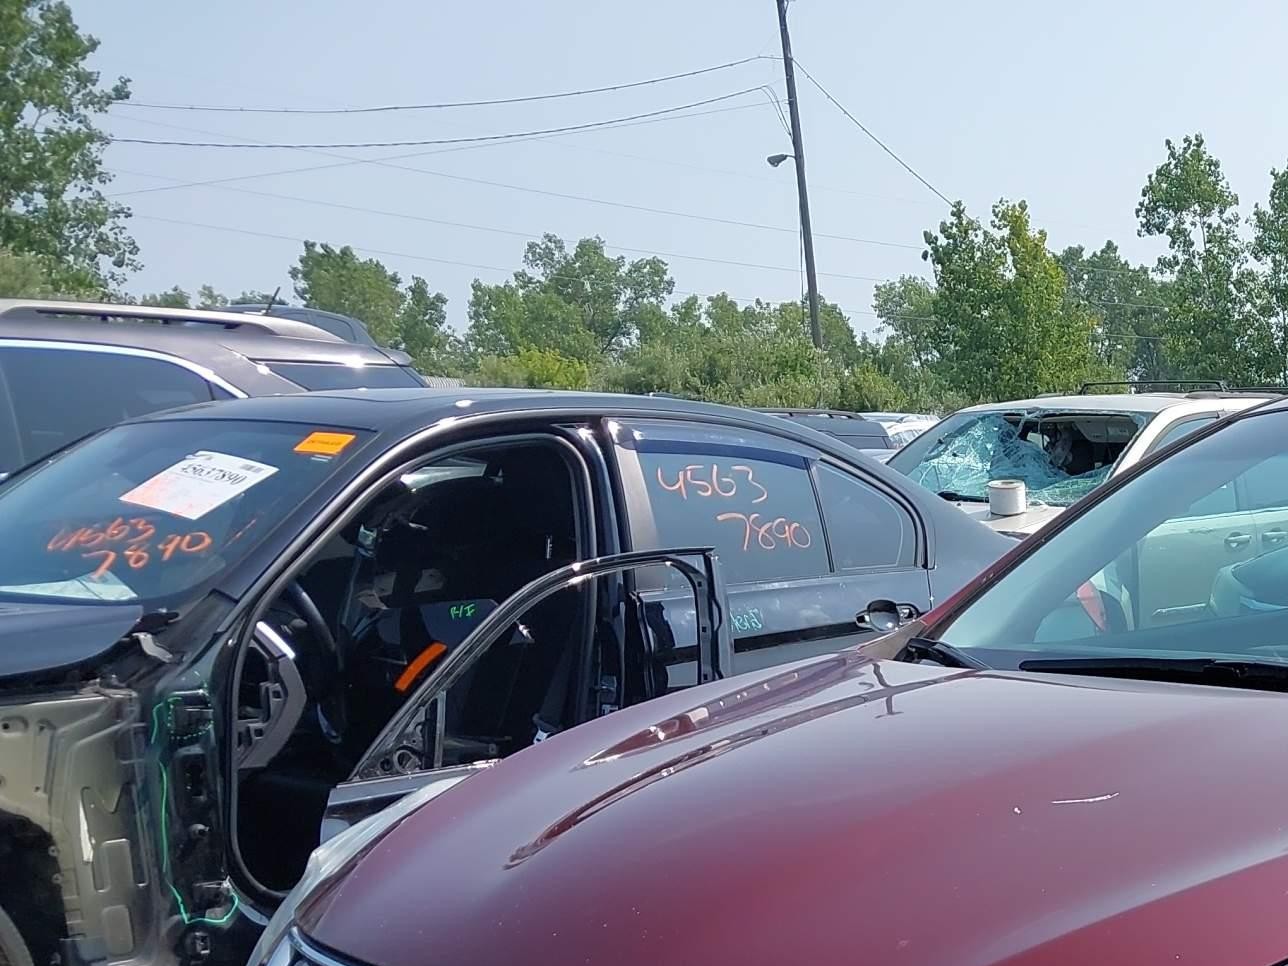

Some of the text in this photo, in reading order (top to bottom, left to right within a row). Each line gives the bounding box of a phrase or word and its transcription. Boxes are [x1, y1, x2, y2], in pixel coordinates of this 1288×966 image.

[657, 464, 768, 504] 4563
[47, 516, 156, 552] 4563
[716, 511, 811, 551] 7890
